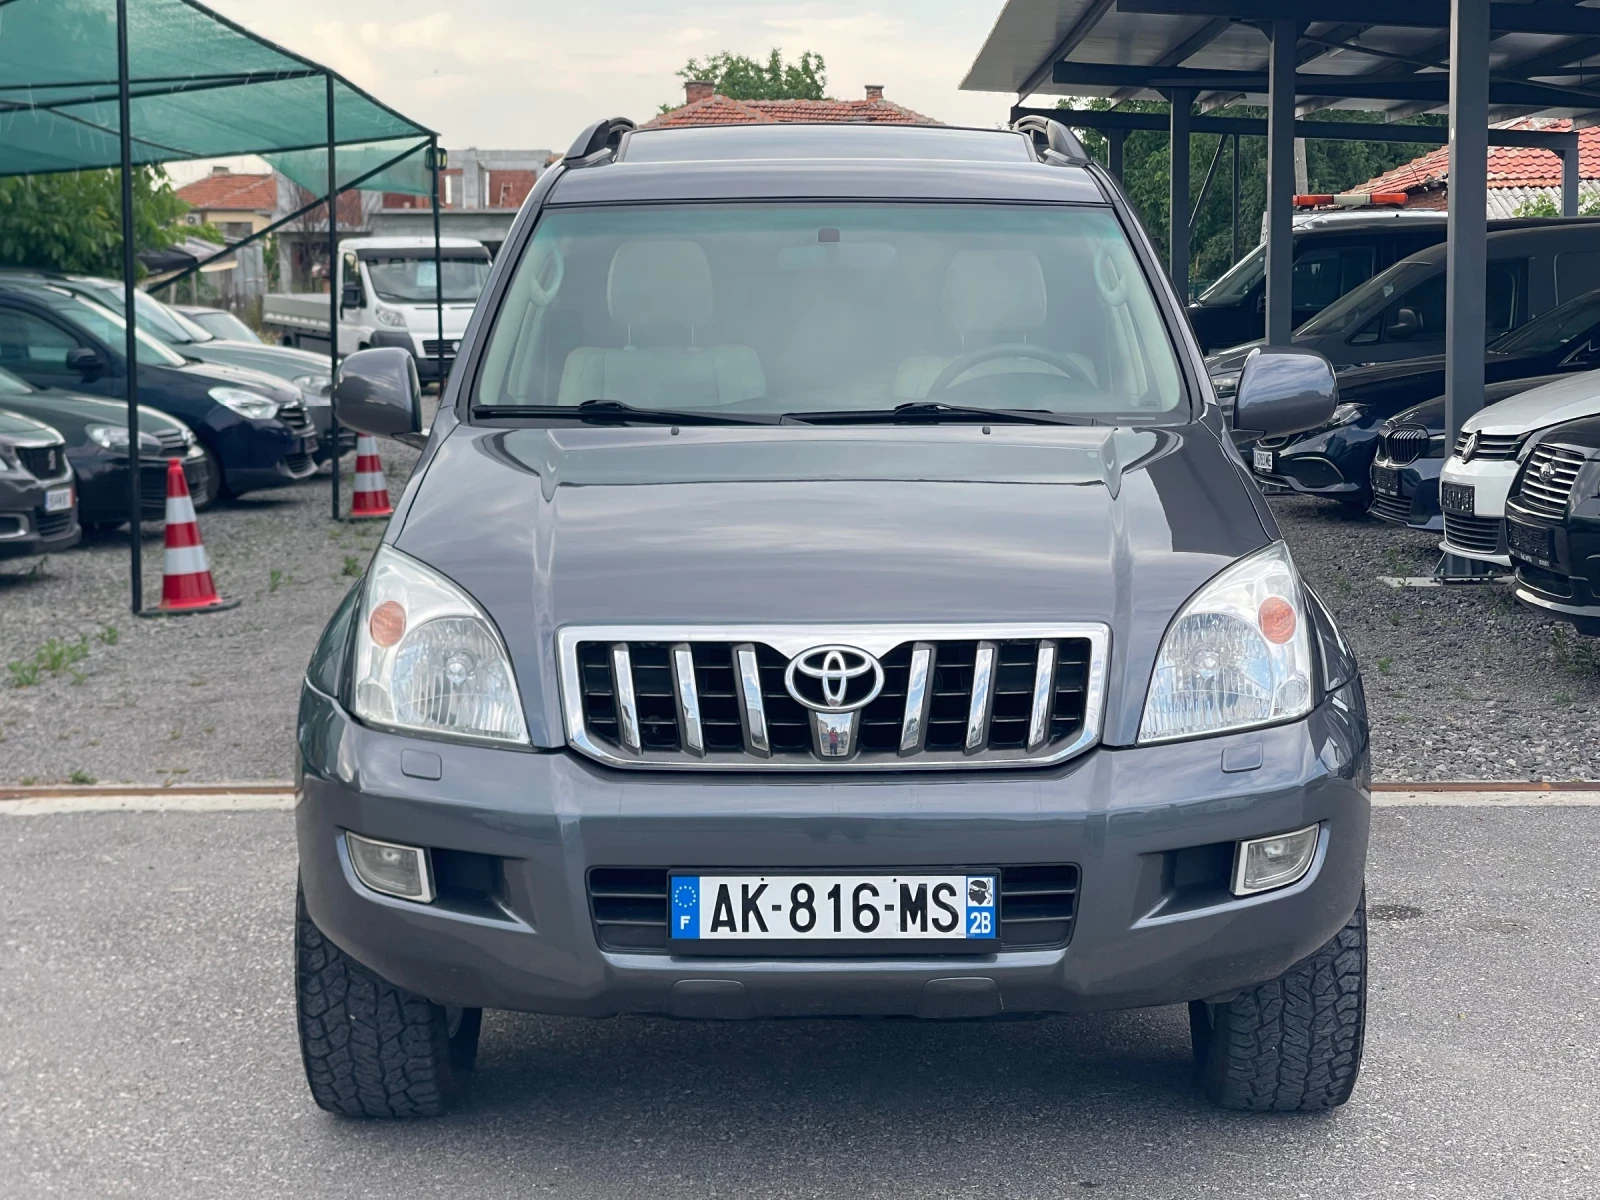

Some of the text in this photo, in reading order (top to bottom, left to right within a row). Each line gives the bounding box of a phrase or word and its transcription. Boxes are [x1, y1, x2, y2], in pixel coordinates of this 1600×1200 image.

[709, 882, 960, 934] AK-816-MS
[680, 916, 691, 930] F
[969, 911, 991, 934] 2B
